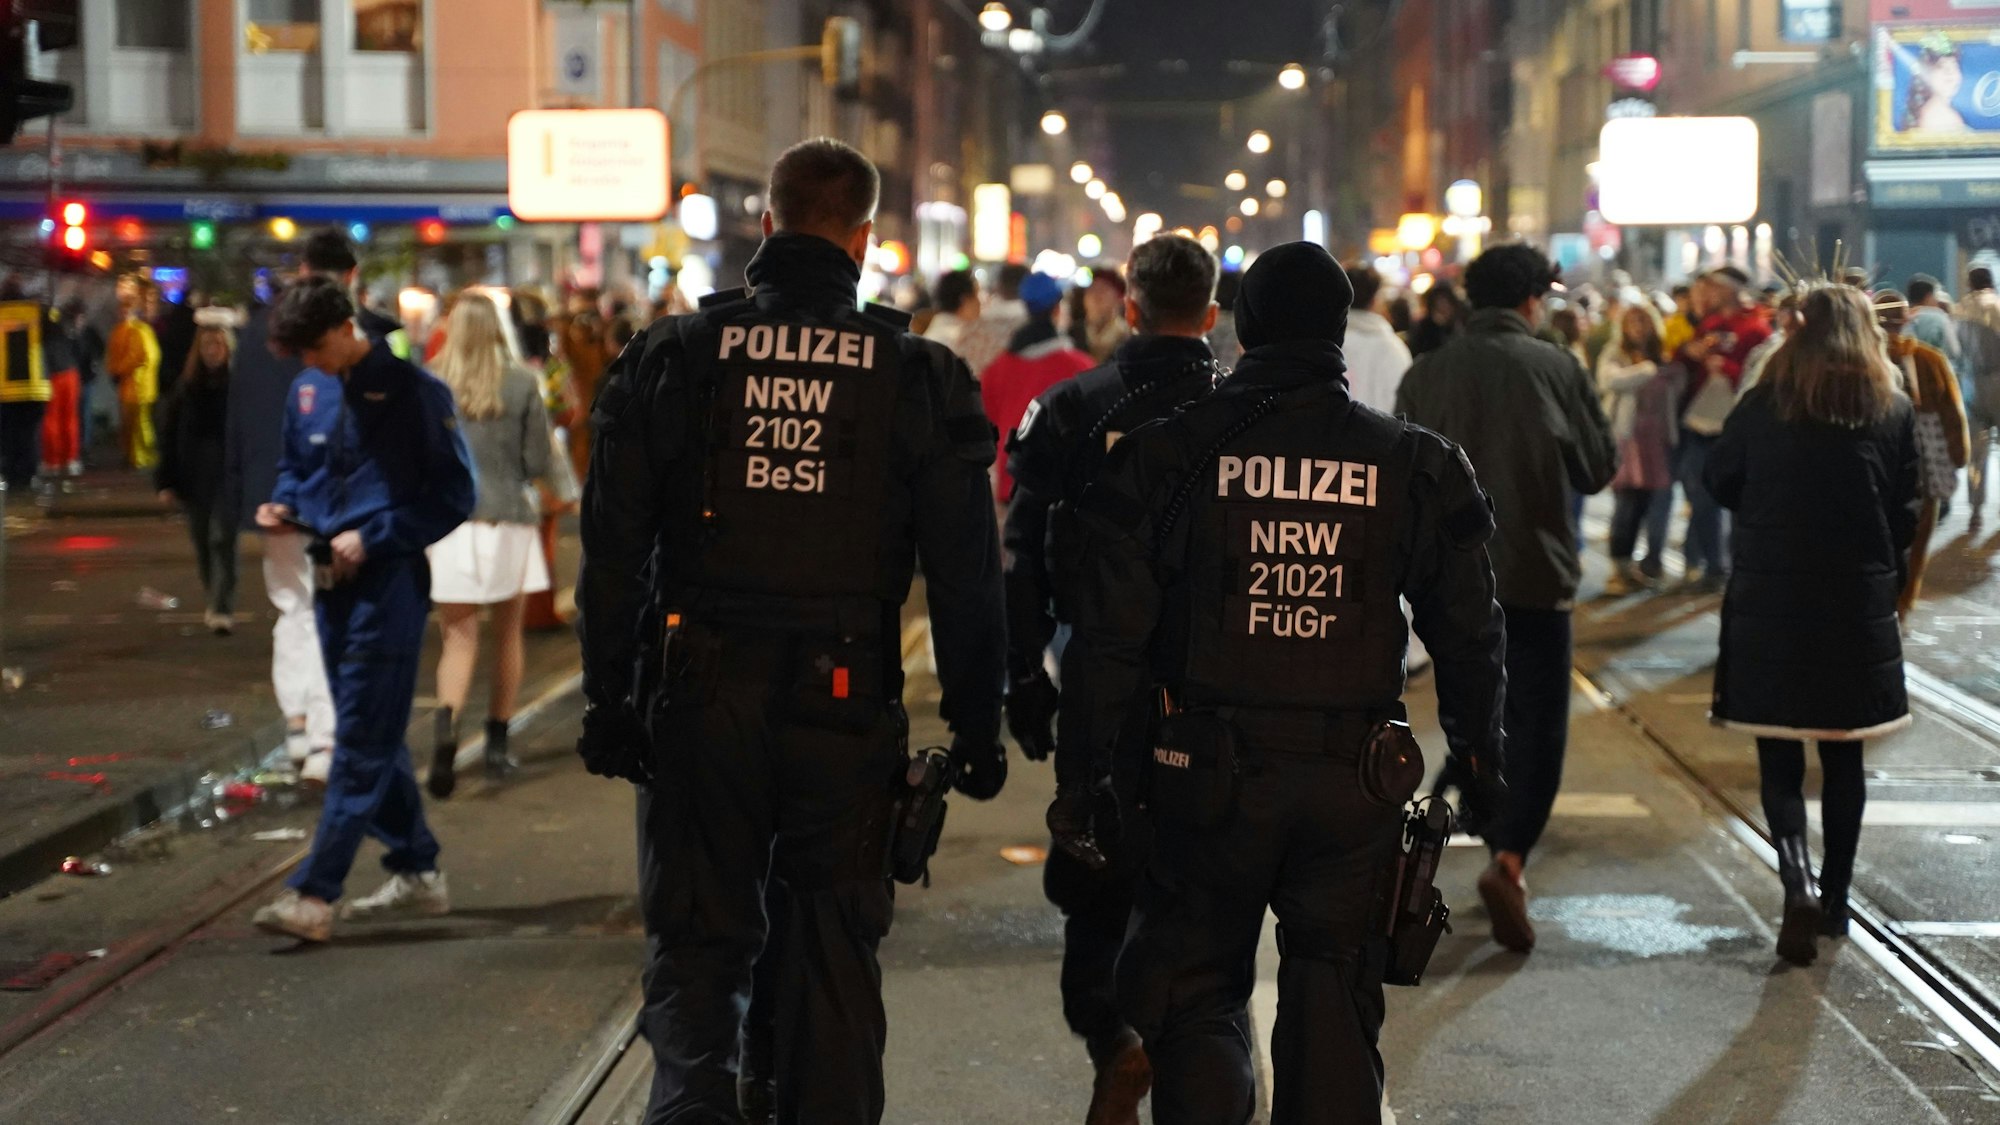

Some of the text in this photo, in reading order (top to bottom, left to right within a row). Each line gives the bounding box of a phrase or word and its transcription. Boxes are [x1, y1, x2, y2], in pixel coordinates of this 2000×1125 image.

[718, 325, 874, 369] POLIZEI
[744, 375, 833, 413] NRW
[745, 415, 822, 451] 2102
[746, 455, 825, 493] BeSi
[1217, 455, 1378, 507] POLIZEI
[1250, 520, 1342, 555] NRW
[1248, 562, 1343, 597] 21021
[1248, 602, 1337, 639] FüGr
[1153, 747, 1190, 769] POLIZEI
